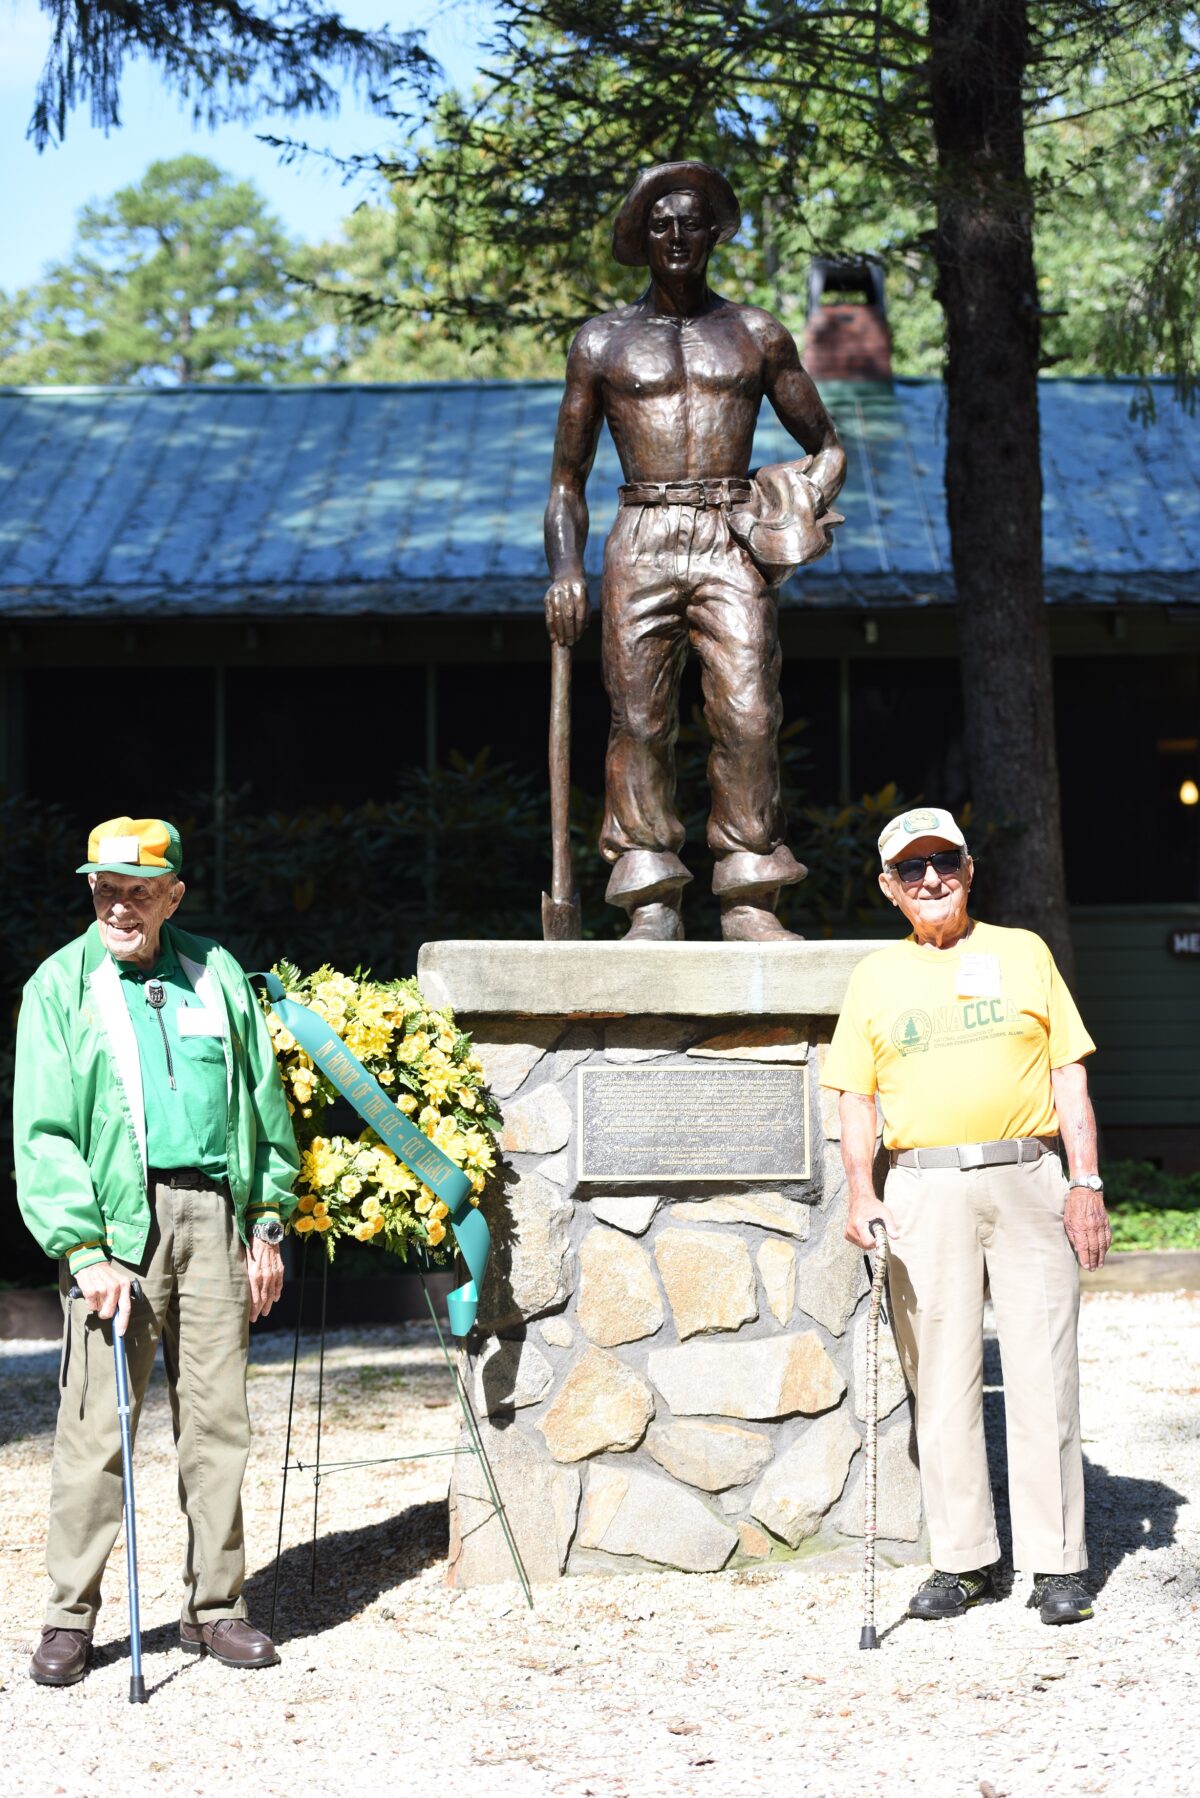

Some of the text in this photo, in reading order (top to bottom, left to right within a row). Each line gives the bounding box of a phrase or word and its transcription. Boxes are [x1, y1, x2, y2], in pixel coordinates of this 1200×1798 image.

[315, 1040, 337, 1059] IN
[325, 1051, 360, 1089] HONOR
[352, 1082, 373, 1101] OF
[363, 1095, 388, 1119] THE
[379, 1113, 403, 1136] CCC
[401, 1136, 426, 1160] CCC
[415, 1149, 454, 1187] LEGACY
